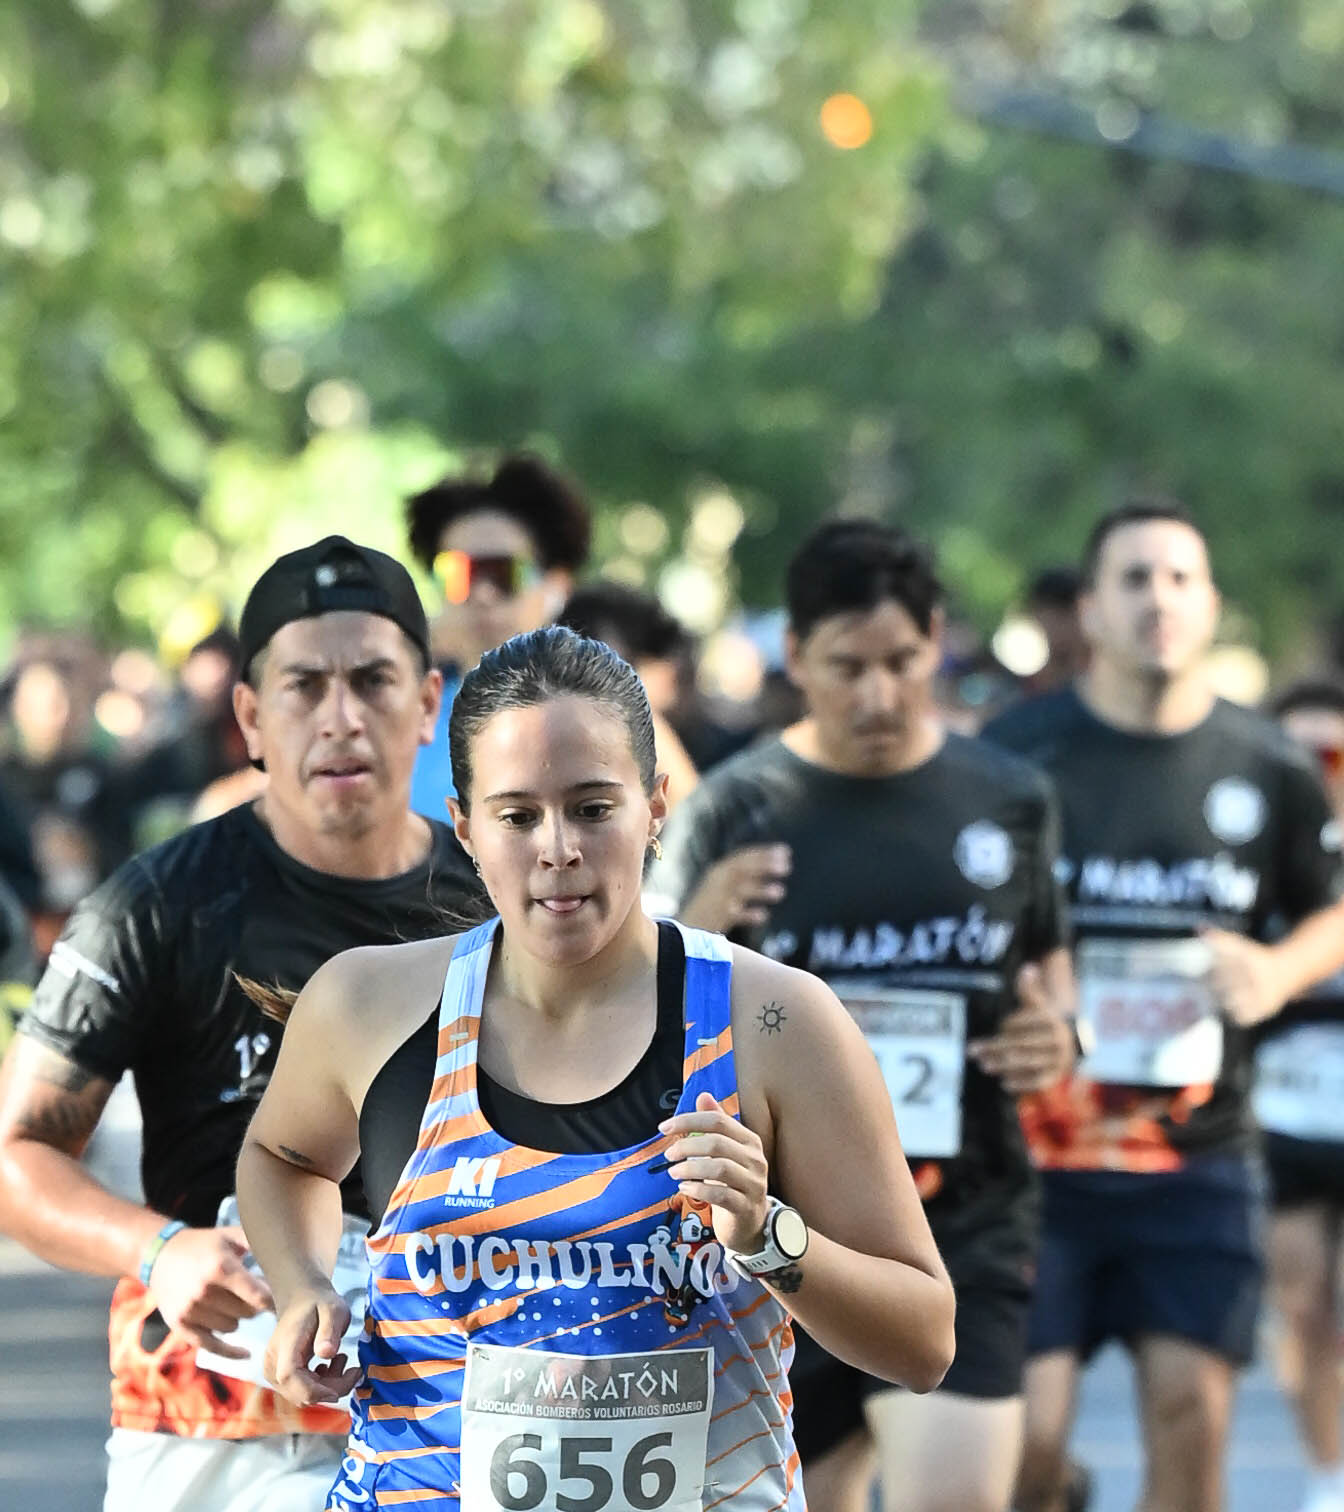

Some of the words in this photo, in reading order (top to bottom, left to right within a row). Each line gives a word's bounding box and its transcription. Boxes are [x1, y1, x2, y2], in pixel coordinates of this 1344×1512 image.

[444, 1196, 496, 1209] RUNNING
[533, 1361, 679, 1402] MARATÓN
[474, 1399, 534, 1416] ASOCIACIÓN
[535, 1404, 592, 1419] BOMBEROS
[593, 1403, 660, 1419] VOLUNTARIOS
[661, 1400, 703, 1414] ROSARIO
